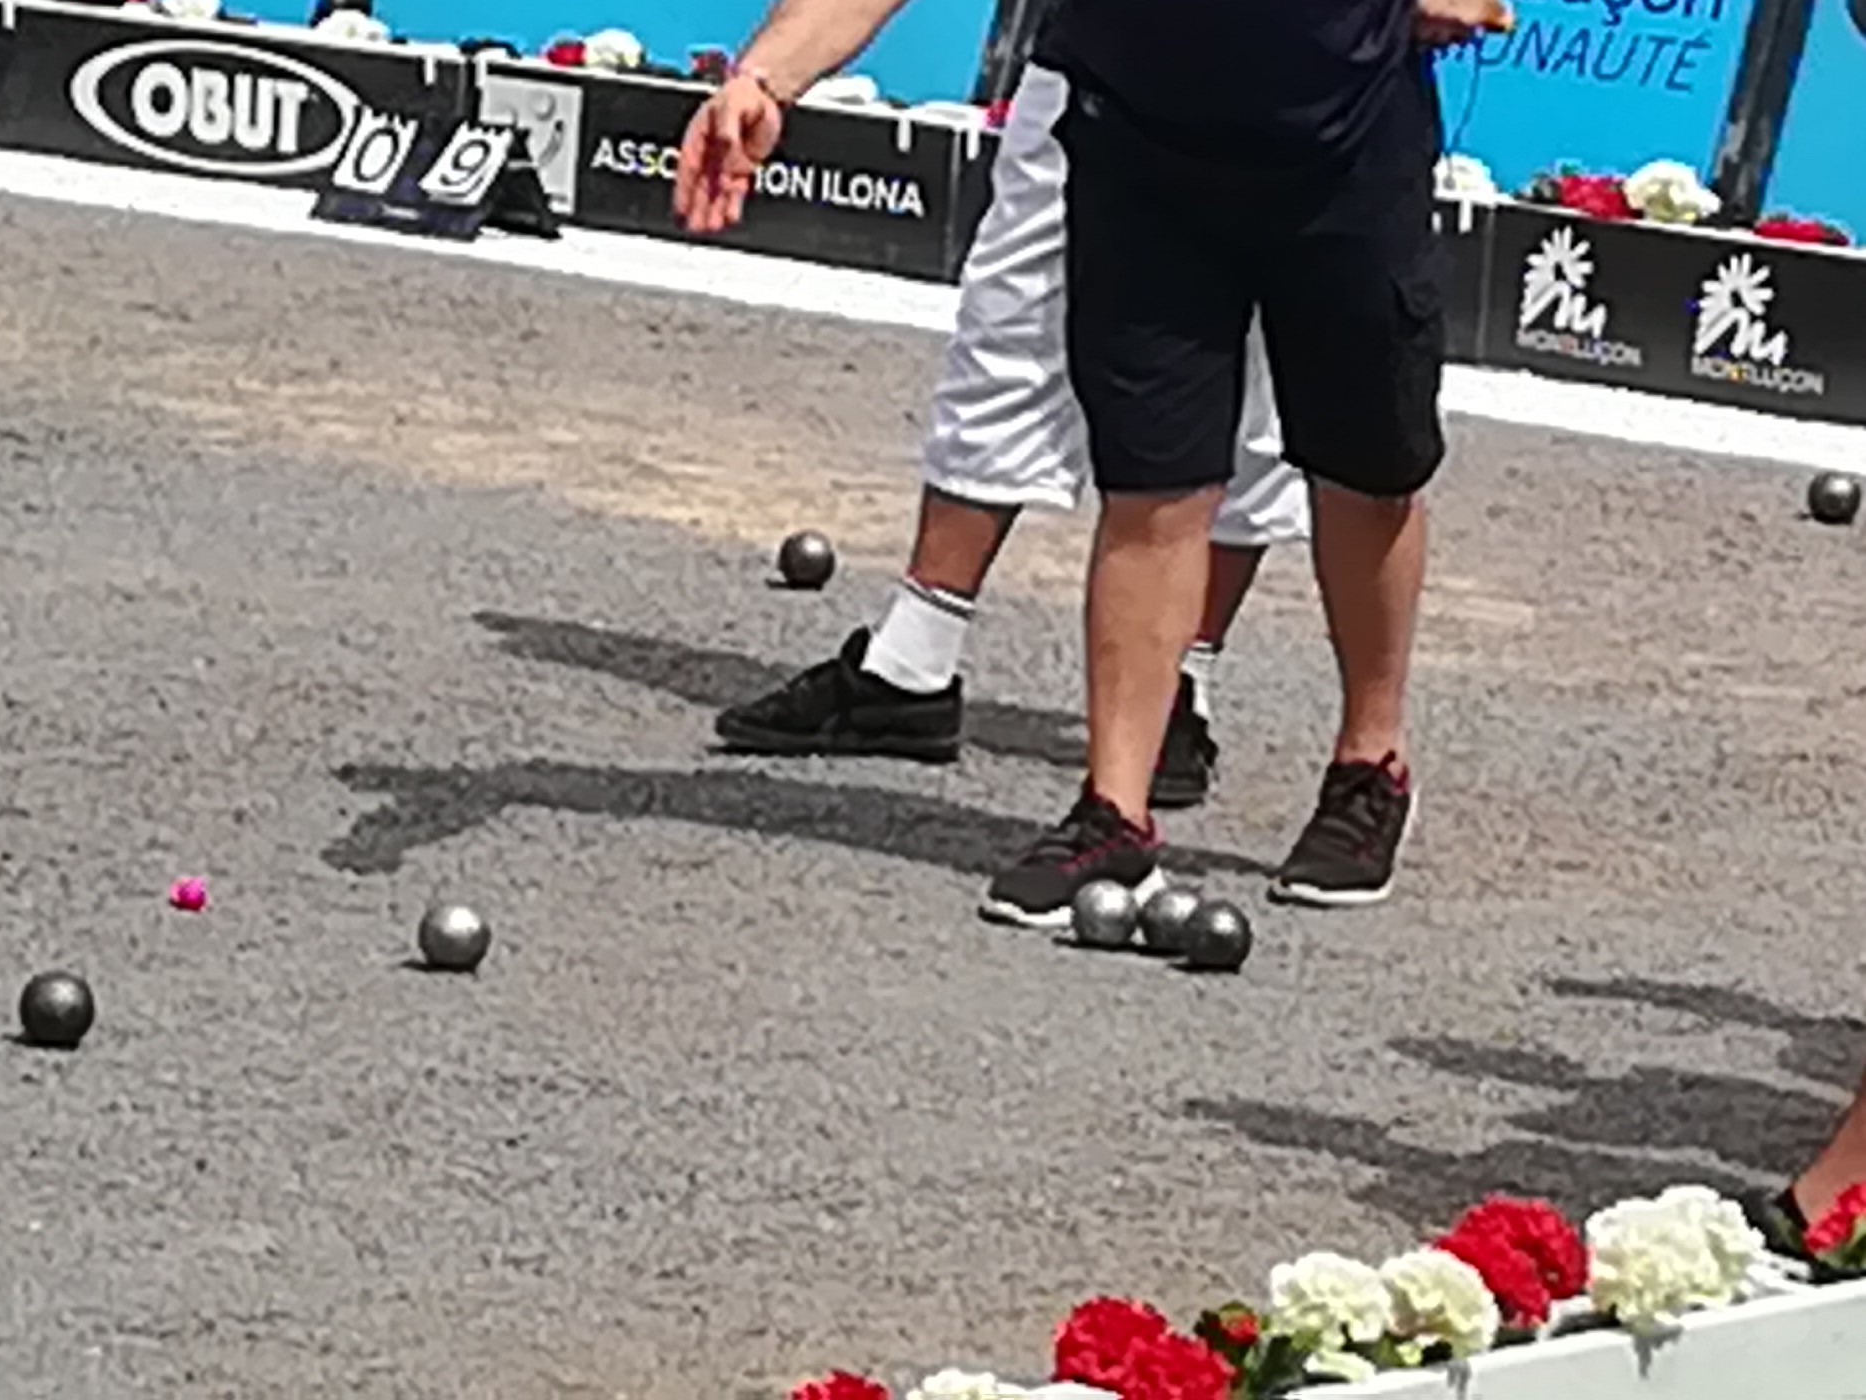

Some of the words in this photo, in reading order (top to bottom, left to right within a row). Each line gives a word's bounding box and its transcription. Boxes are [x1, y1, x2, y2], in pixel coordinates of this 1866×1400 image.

[133, 62, 308, 153] OBUT
[591, 138, 813, 200] ASSOION
[822, 170, 924, 217] ILONA
